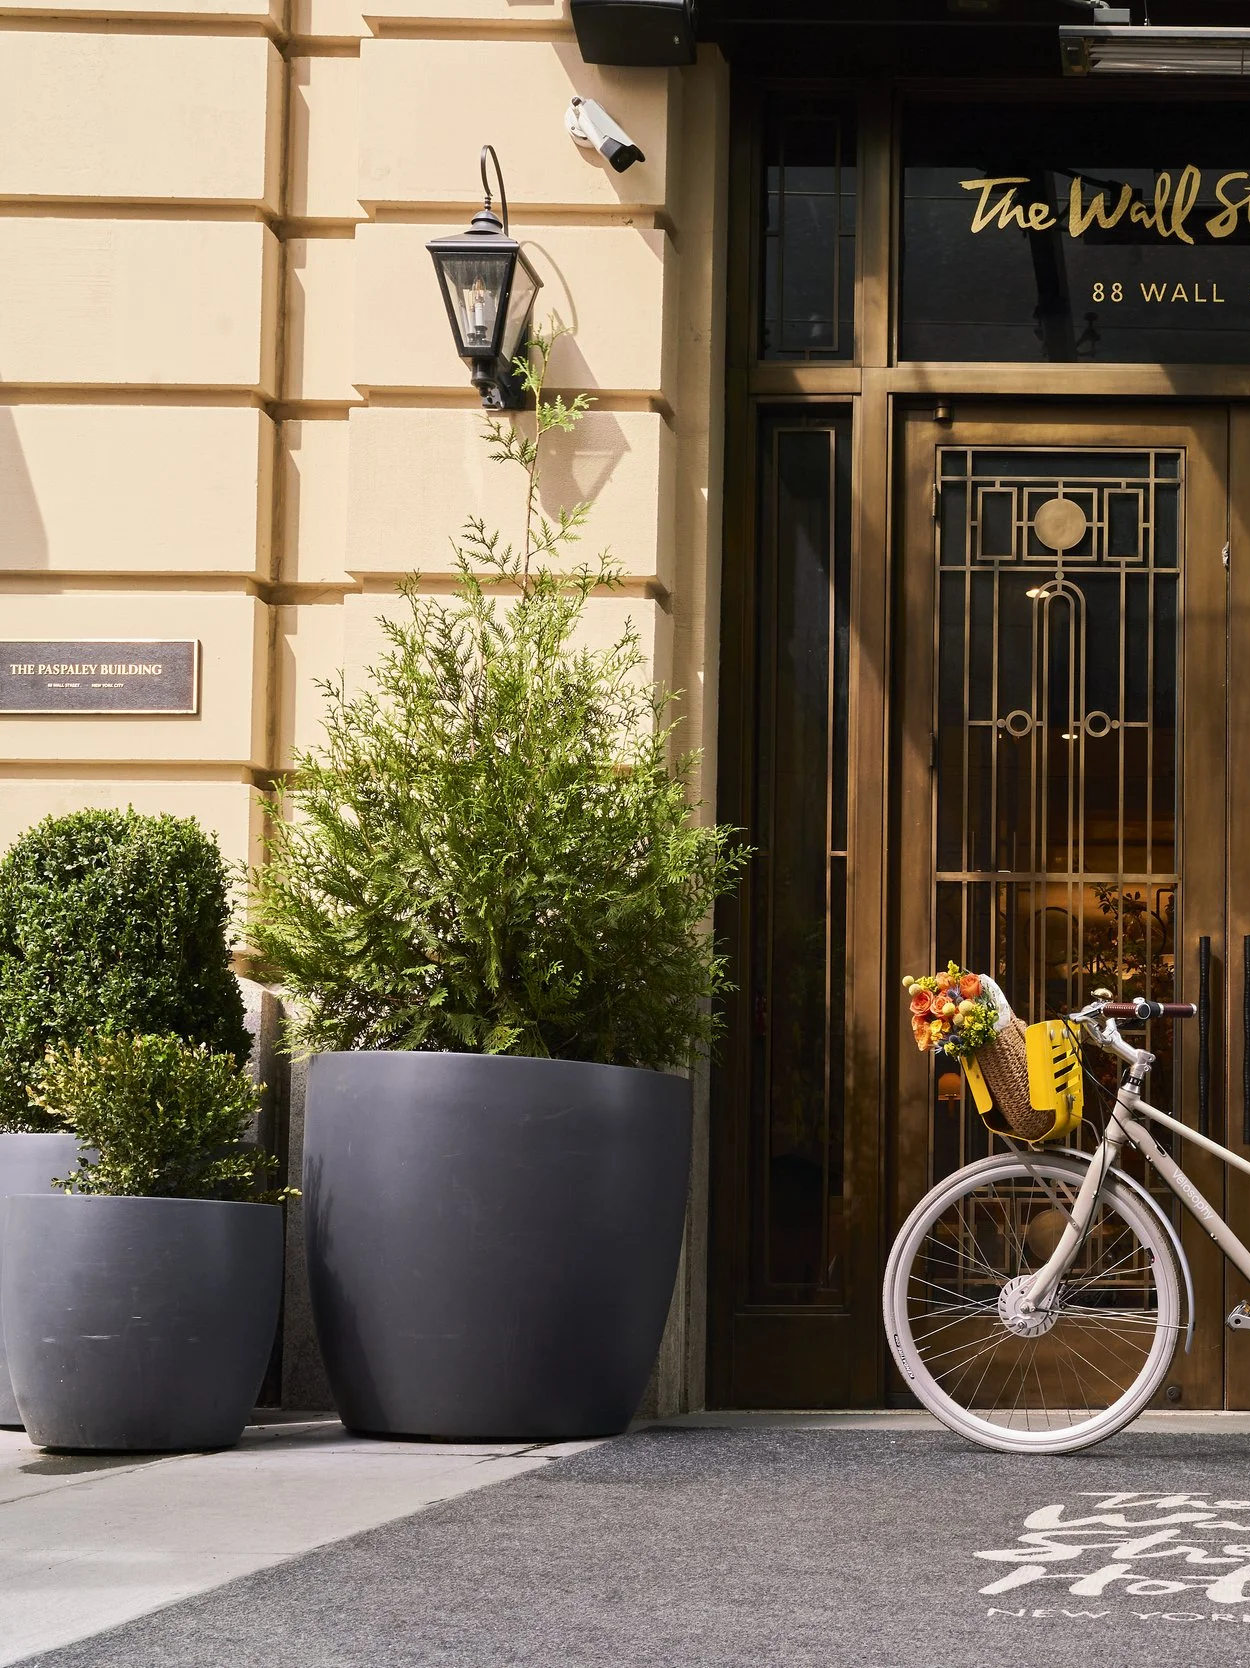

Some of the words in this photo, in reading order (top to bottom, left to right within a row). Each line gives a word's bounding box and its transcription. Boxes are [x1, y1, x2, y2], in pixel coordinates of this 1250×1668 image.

[959, 177, 1056, 234] The
[1069, 165, 1202, 245] Wall
[1092, 282, 1124, 303] 88
[1139, 282, 1225, 303] WALL
[10, 664, 35, 676] THE
[38, 664, 97, 676] PASPALEY
[100, 664, 162, 676] BUILDING
[986, 1607, 1110, 1619] NEW
